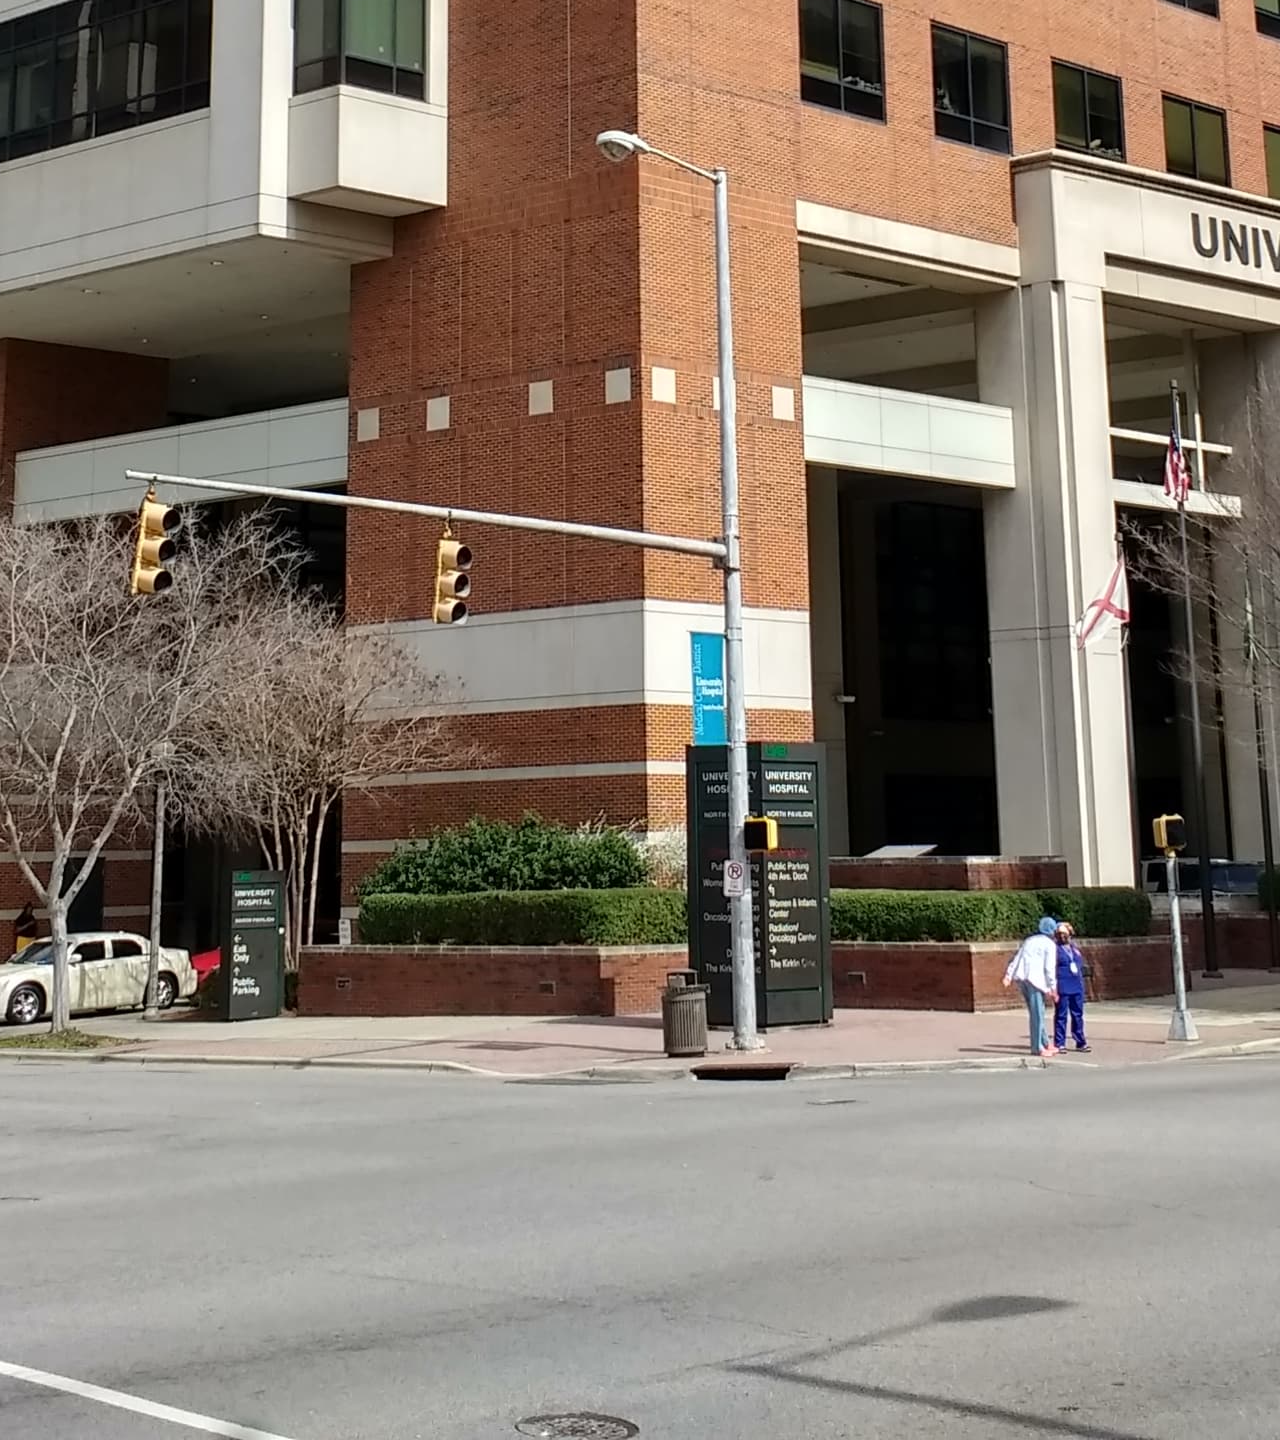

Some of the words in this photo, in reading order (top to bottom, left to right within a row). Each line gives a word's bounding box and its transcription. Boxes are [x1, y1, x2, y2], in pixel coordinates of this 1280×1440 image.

[702, 771, 758, 782] UNIVETY
[765, 770, 812, 781] UNIVERSITY
[769, 783, 809, 794] HOSPITAL
[766, 810, 786, 818] NORTH
[767, 861, 787, 871] Public
[787, 861, 809, 872] Parking
[768, 898, 792, 908] Women
[768, 908, 790, 919] Center
[768, 933, 797, 945] Oncology
[233, 953, 250, 964] Only
[770, 959, 782, 969] The
